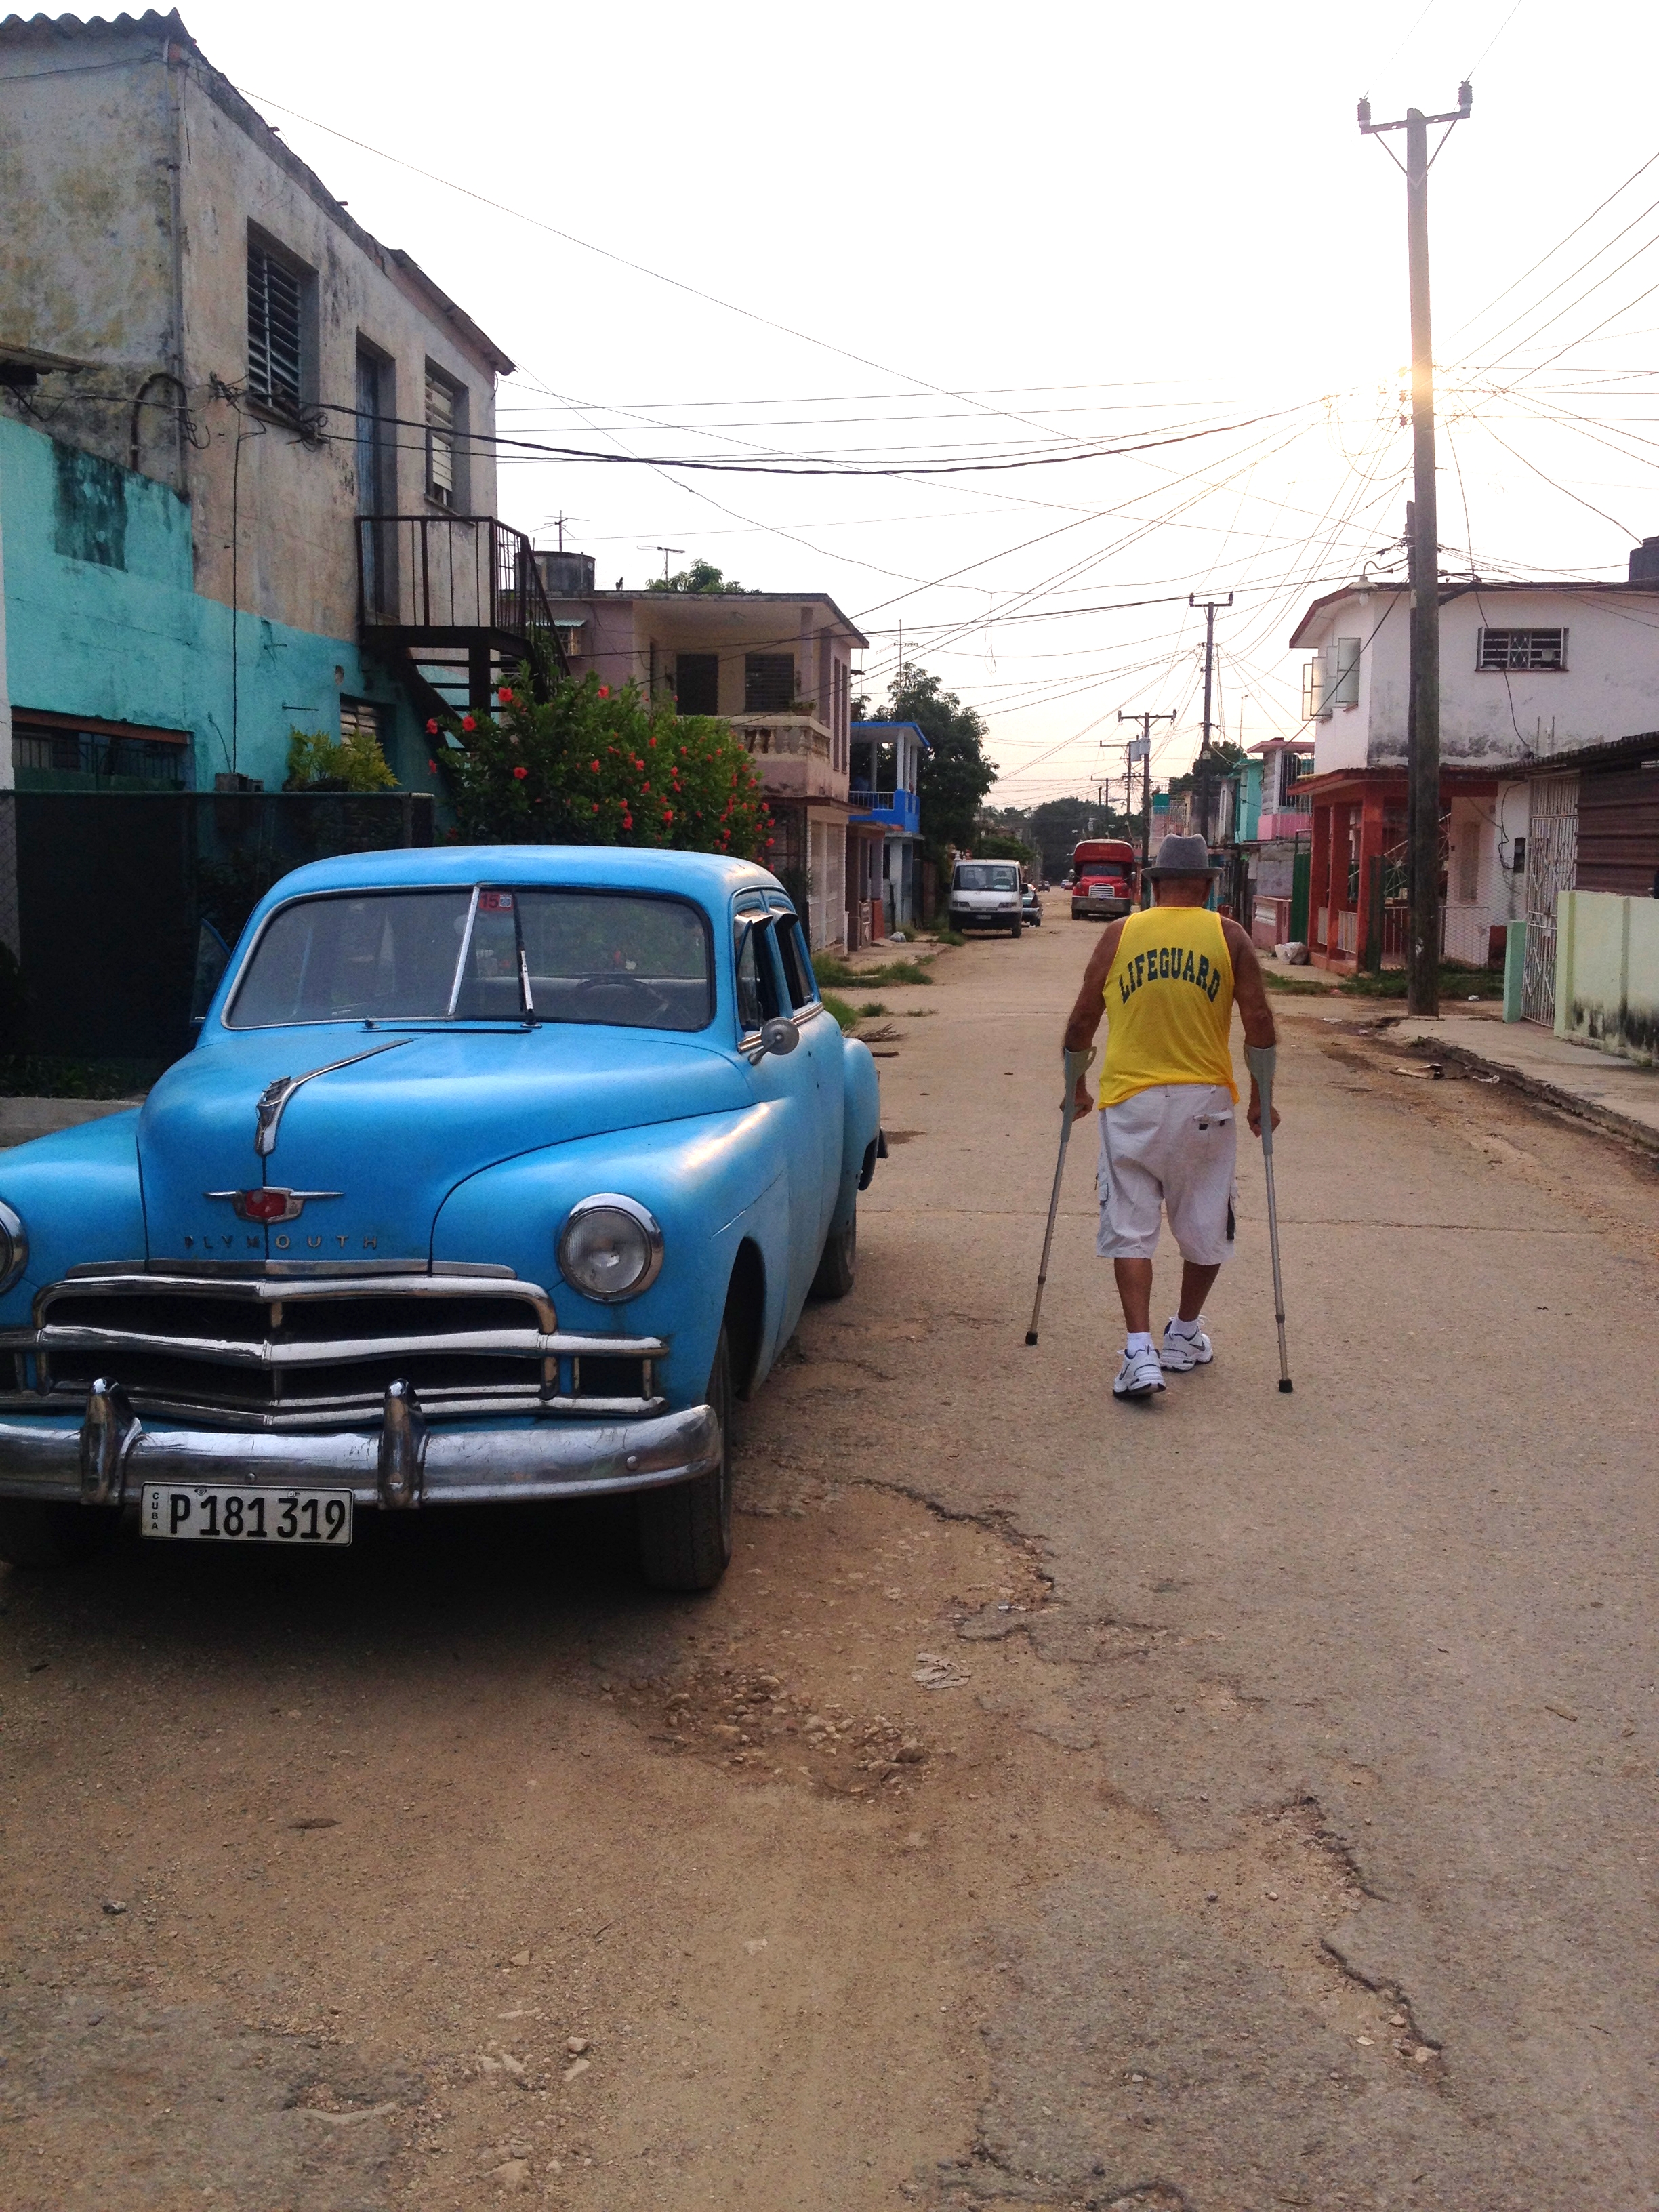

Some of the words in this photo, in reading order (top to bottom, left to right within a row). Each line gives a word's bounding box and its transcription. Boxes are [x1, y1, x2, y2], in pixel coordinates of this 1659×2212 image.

[480, 894, 499, 908] 15
[1119, 947, 1221, 1005] LIFEGUARD
[184, 1235, 377, 1250] PLYMOUTH
